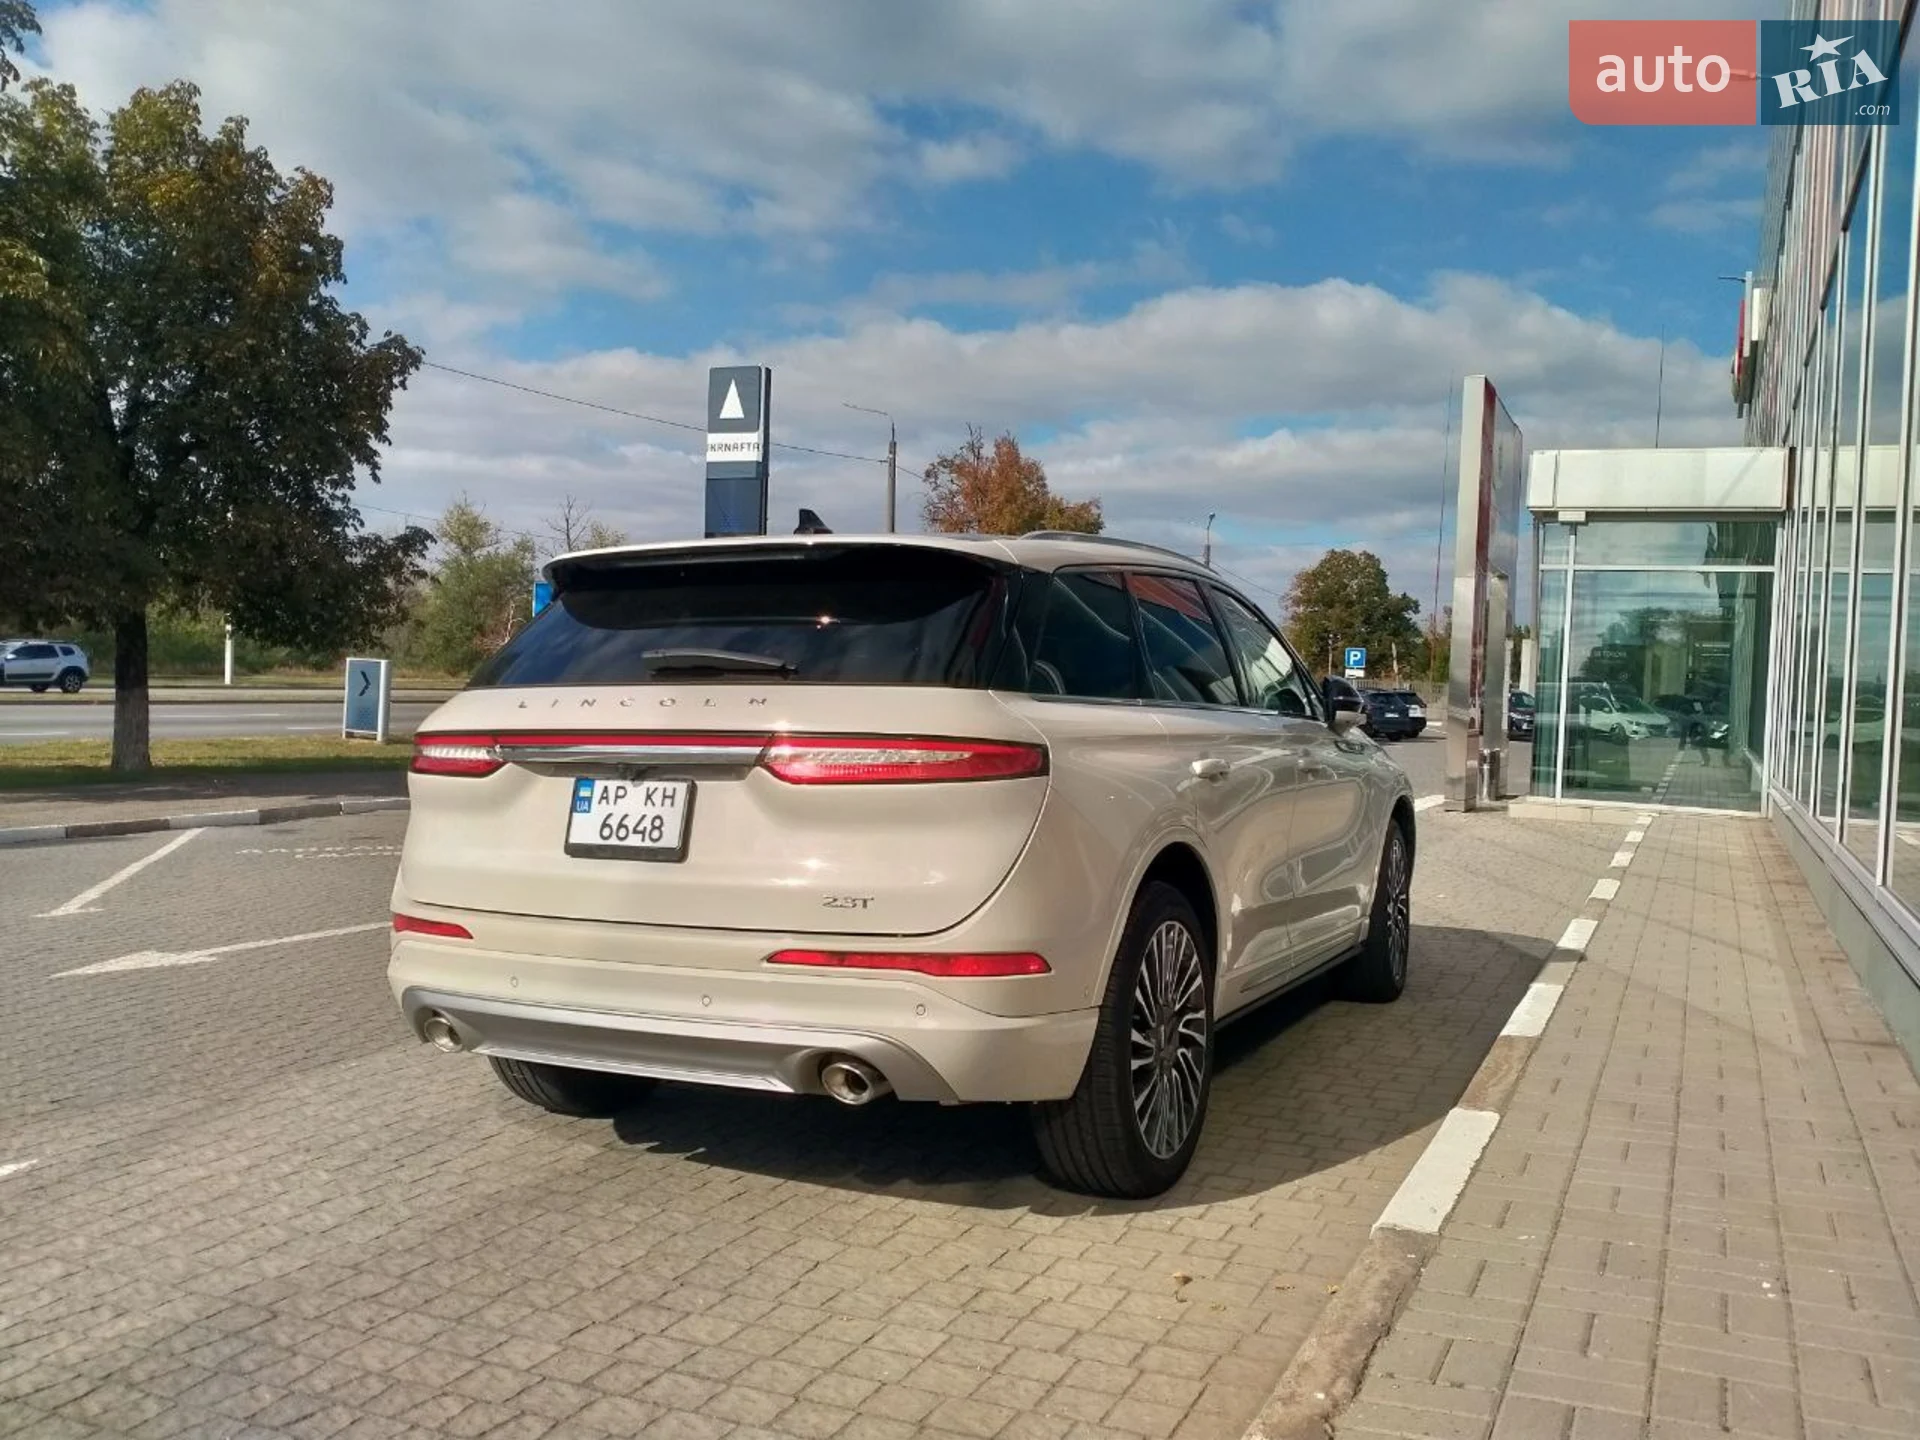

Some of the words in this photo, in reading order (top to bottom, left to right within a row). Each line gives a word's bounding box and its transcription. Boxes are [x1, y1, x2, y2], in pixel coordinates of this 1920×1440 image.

[1349, 650, 1361, 665] P
[517, 697, 768, 709] LINCOLN
[597, 785, 628, 805] AP
[644, 786, 677, 807] KH
[576, 800, 589, 811] UA
[598, 812, 664, 844] 6648
